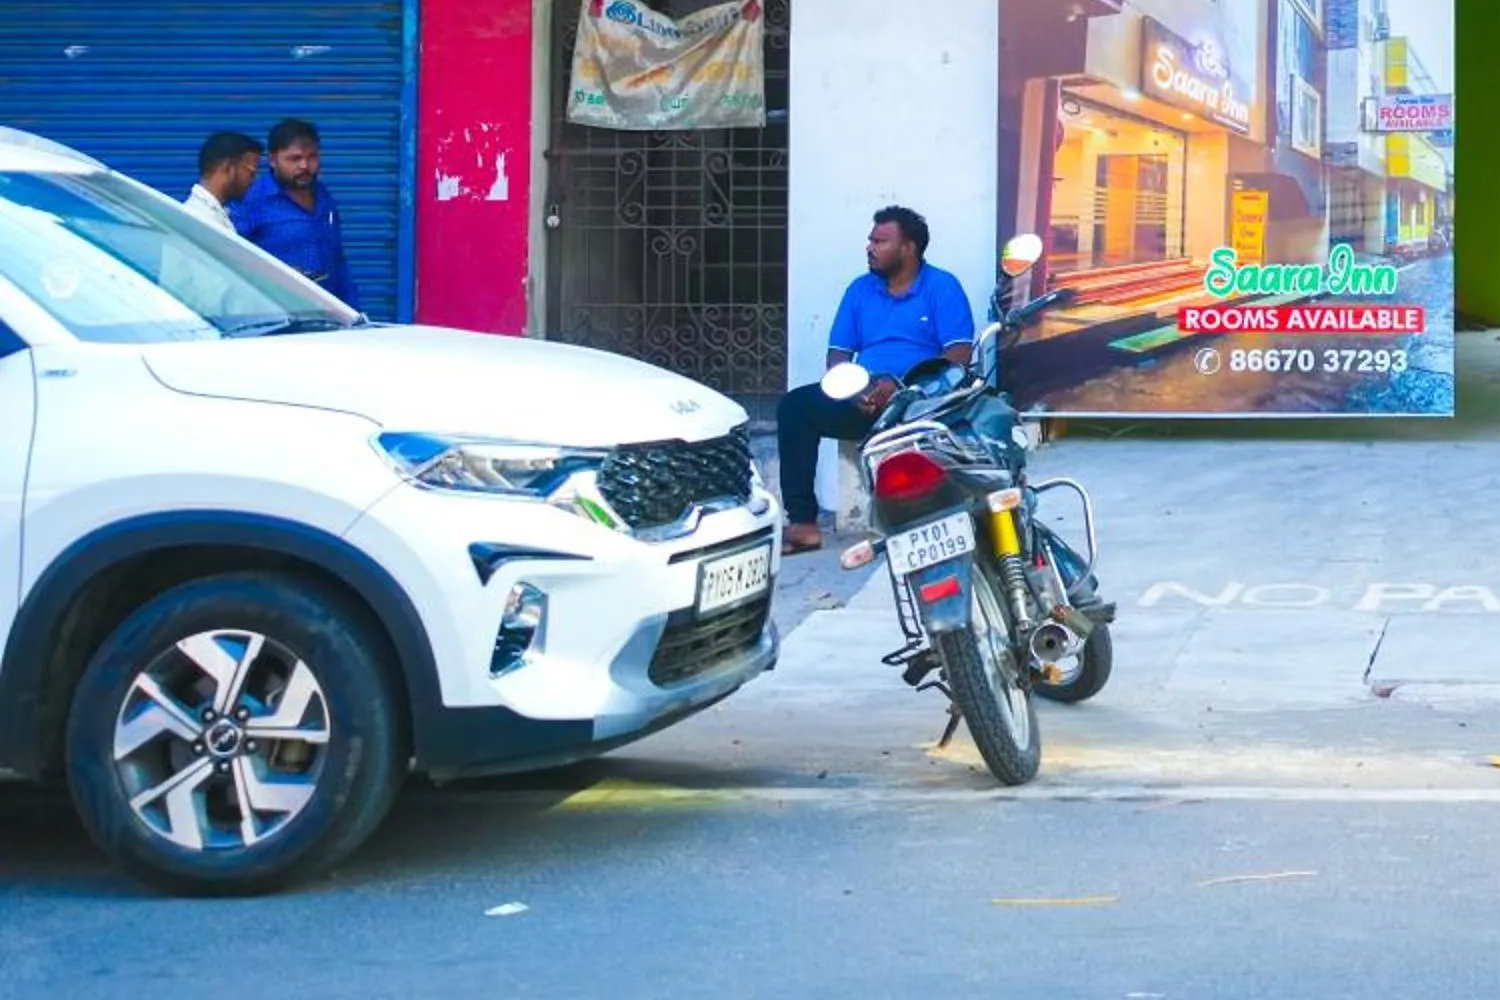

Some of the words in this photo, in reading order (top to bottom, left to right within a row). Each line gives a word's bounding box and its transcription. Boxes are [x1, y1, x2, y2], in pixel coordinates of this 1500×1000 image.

[1380, 104, 1450, 119] ROOMS
[1205, 248, 1320, 297] Saara
[1328, 244, 1397, 295] Inn
[1186, 309, 1279, 329] ROOMS
[1287, 309, 1418, 329] AVAILABLE
[1230, 350, 1314, 371] 86670
[1323, 350, 1408, 371] 37293
[1138, 581, 1330, 607] NO
